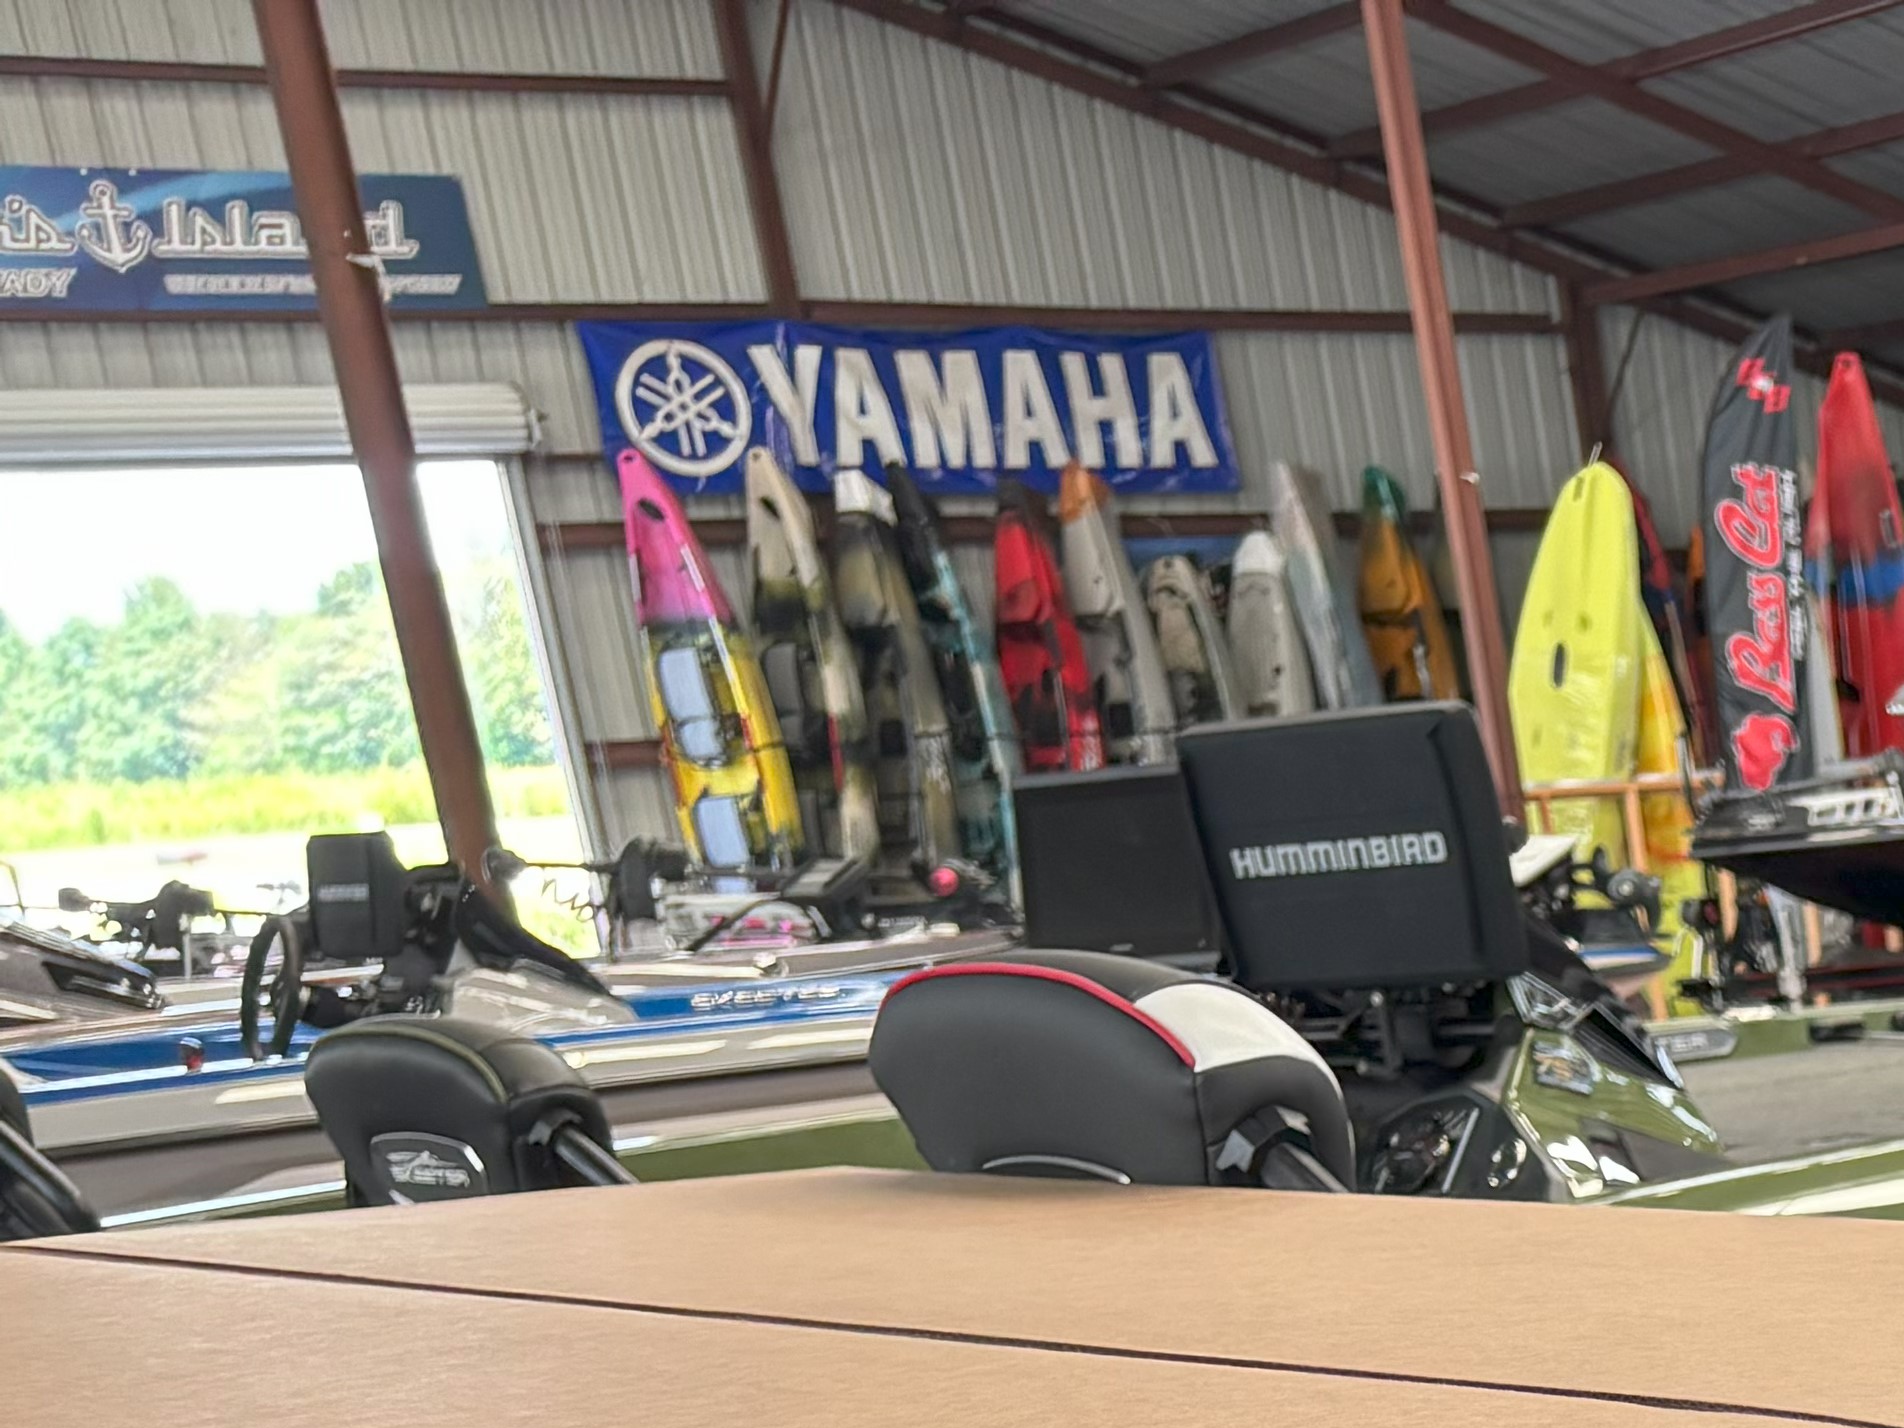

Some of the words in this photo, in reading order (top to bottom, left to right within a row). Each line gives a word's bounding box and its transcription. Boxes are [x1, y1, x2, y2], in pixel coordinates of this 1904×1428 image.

[745, 344, 1219, 469] YAMAHA
[1714, 460, 1784, 570] Cat
[1229, 831, 1448, 879] HUMMINBIRD
